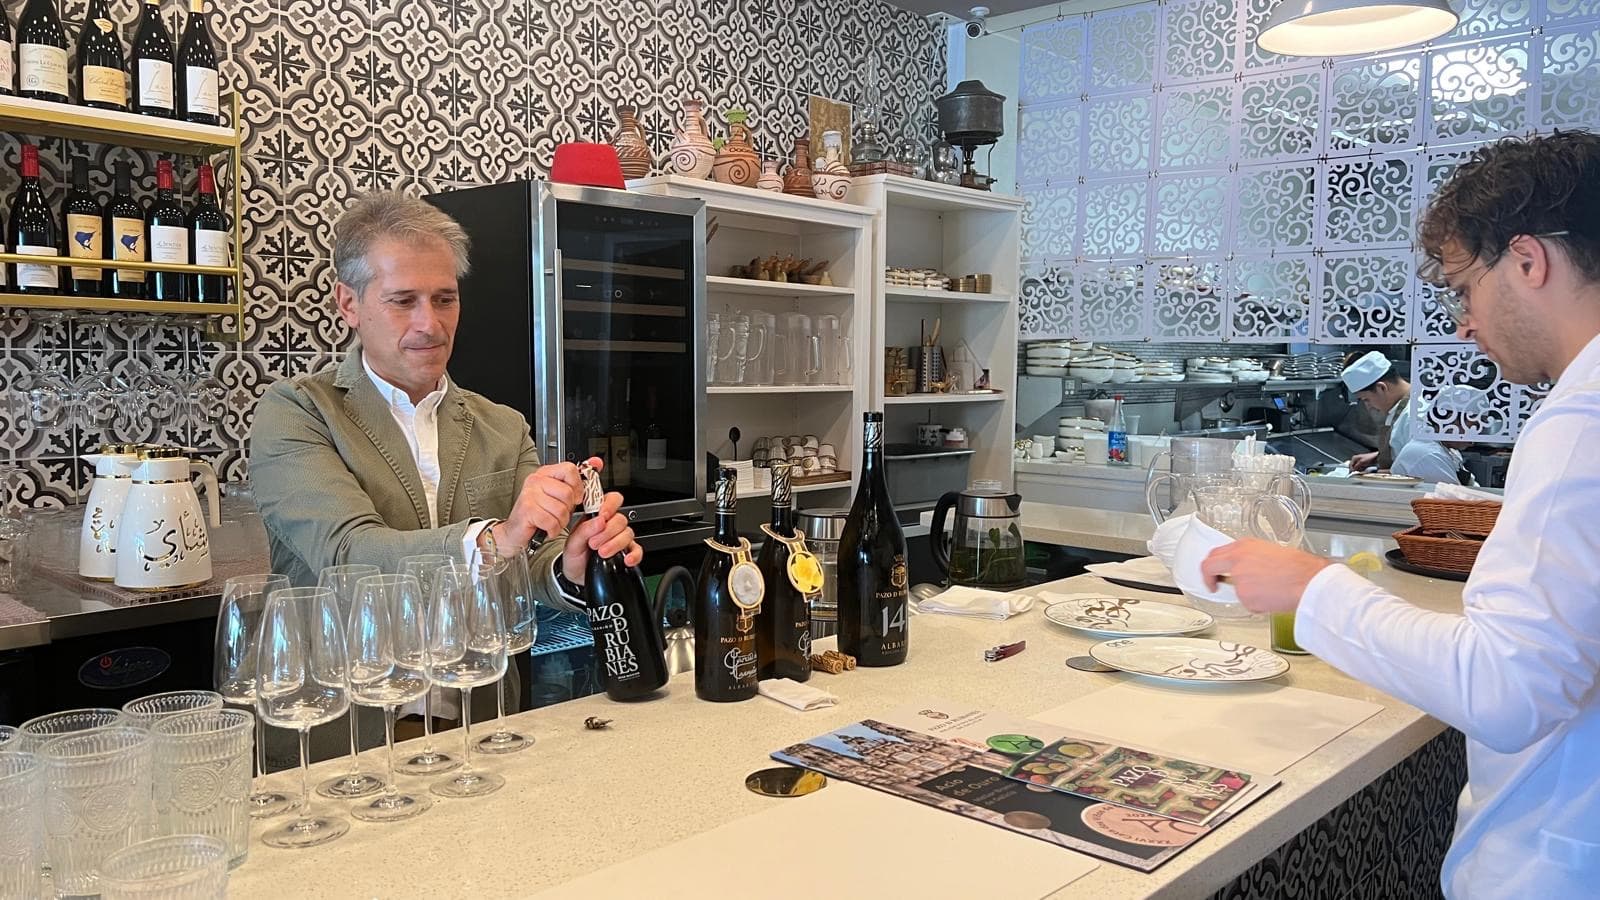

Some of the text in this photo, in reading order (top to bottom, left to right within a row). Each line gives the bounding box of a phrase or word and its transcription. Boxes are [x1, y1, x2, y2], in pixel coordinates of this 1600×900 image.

[586, 602, 625, 623] PAZO
[604, 629, 631, 648] RU
[604, 645, 636, 663] BIA
[605, 656, 640, 677] NES
[1110, 764, 1153, 788] PAZO
